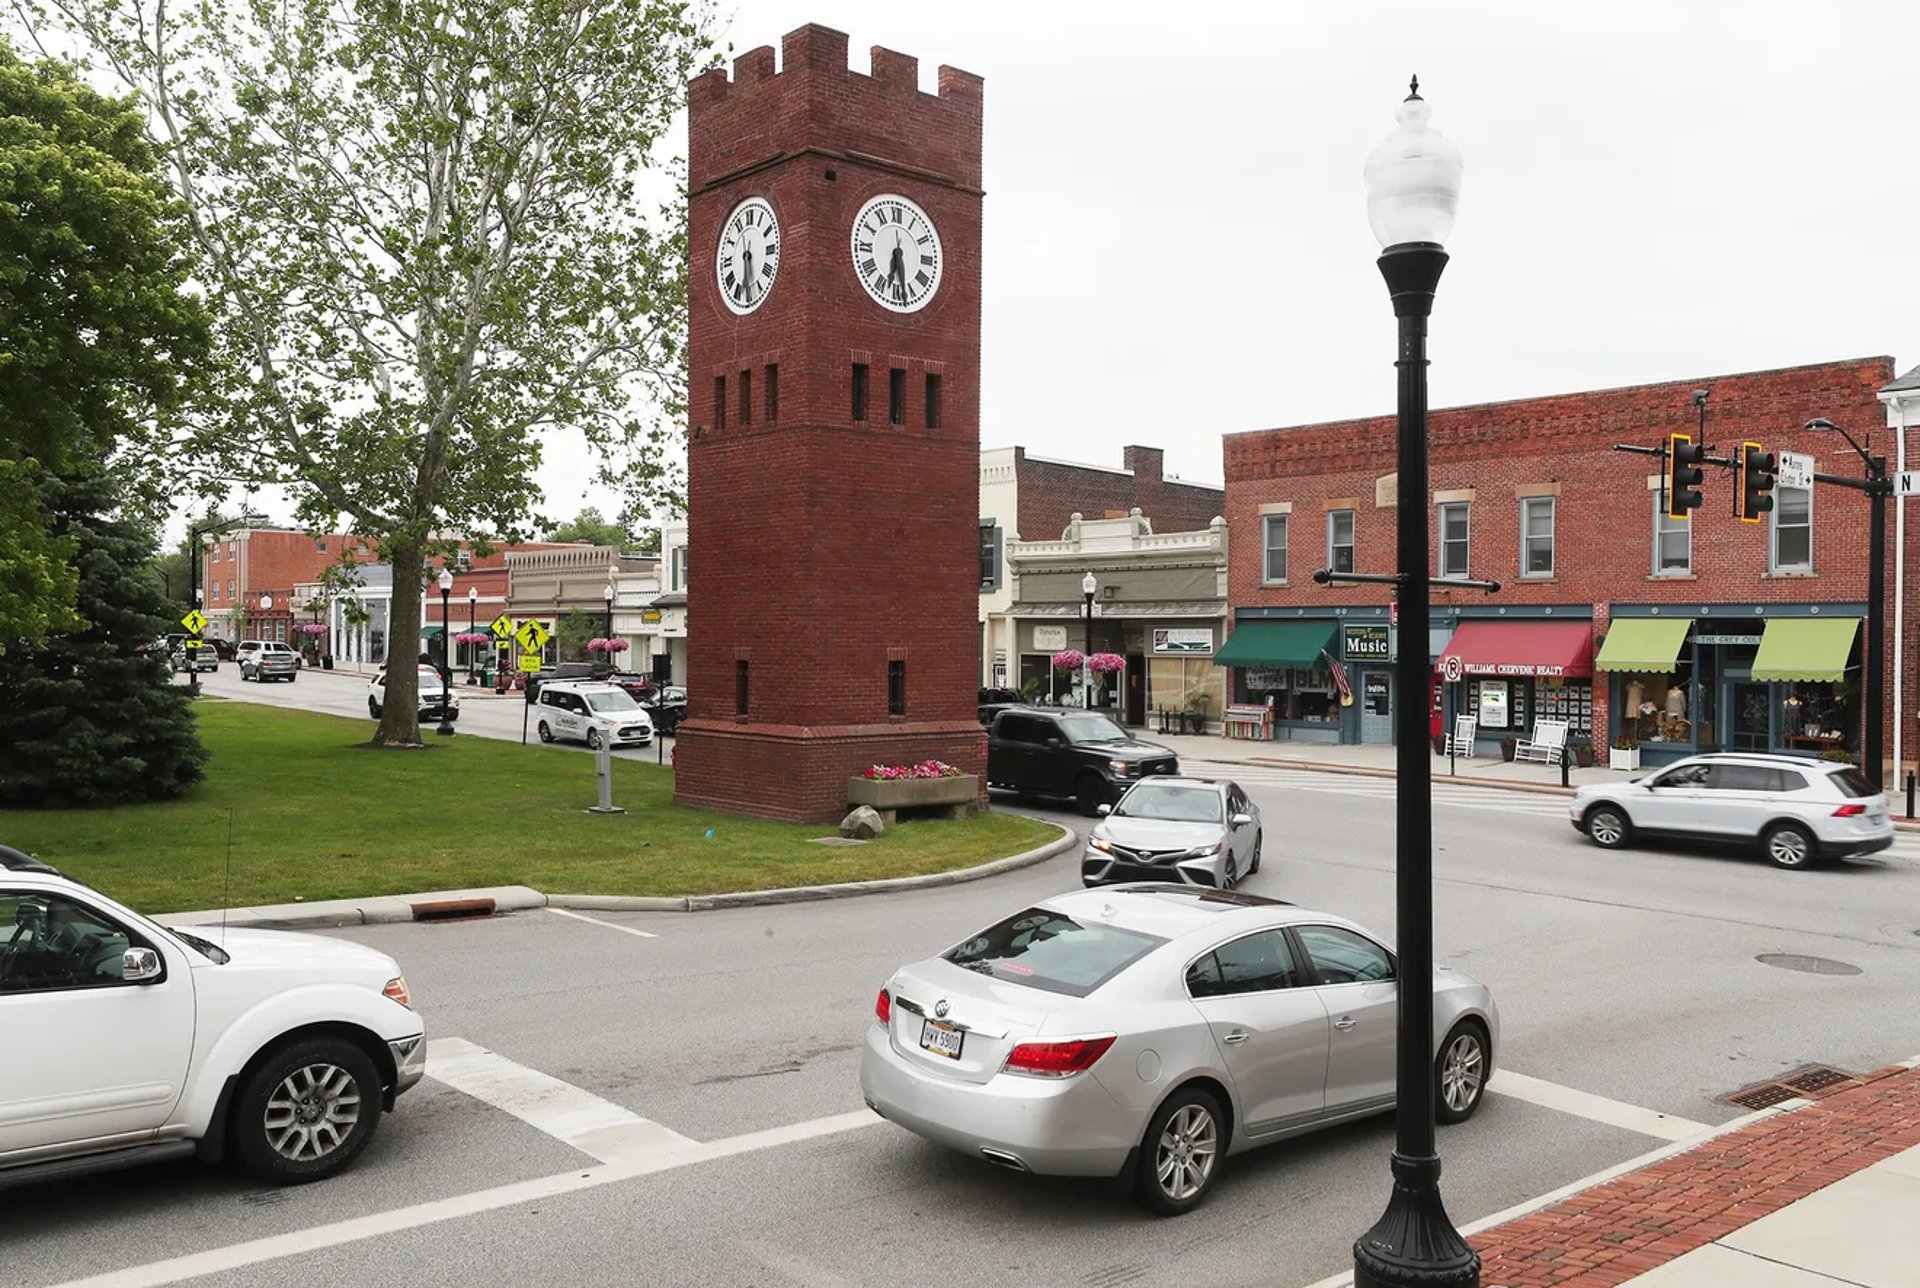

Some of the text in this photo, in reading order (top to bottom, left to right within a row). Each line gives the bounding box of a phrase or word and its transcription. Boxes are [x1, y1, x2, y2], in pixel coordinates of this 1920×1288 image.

[874, 208, 888, 226] XI
[863, 221, 877, 236] X
[1901, 474, 1911, 492] N
[1347, 638, 1387, 652] Music
[1464, 663, 1495, 673] WILLIAMS
[1537, 665, 1564, 675] REALTY
[1295, 668, 1333, 689] BLM
[940, 1032, 958, 1051] 5900
